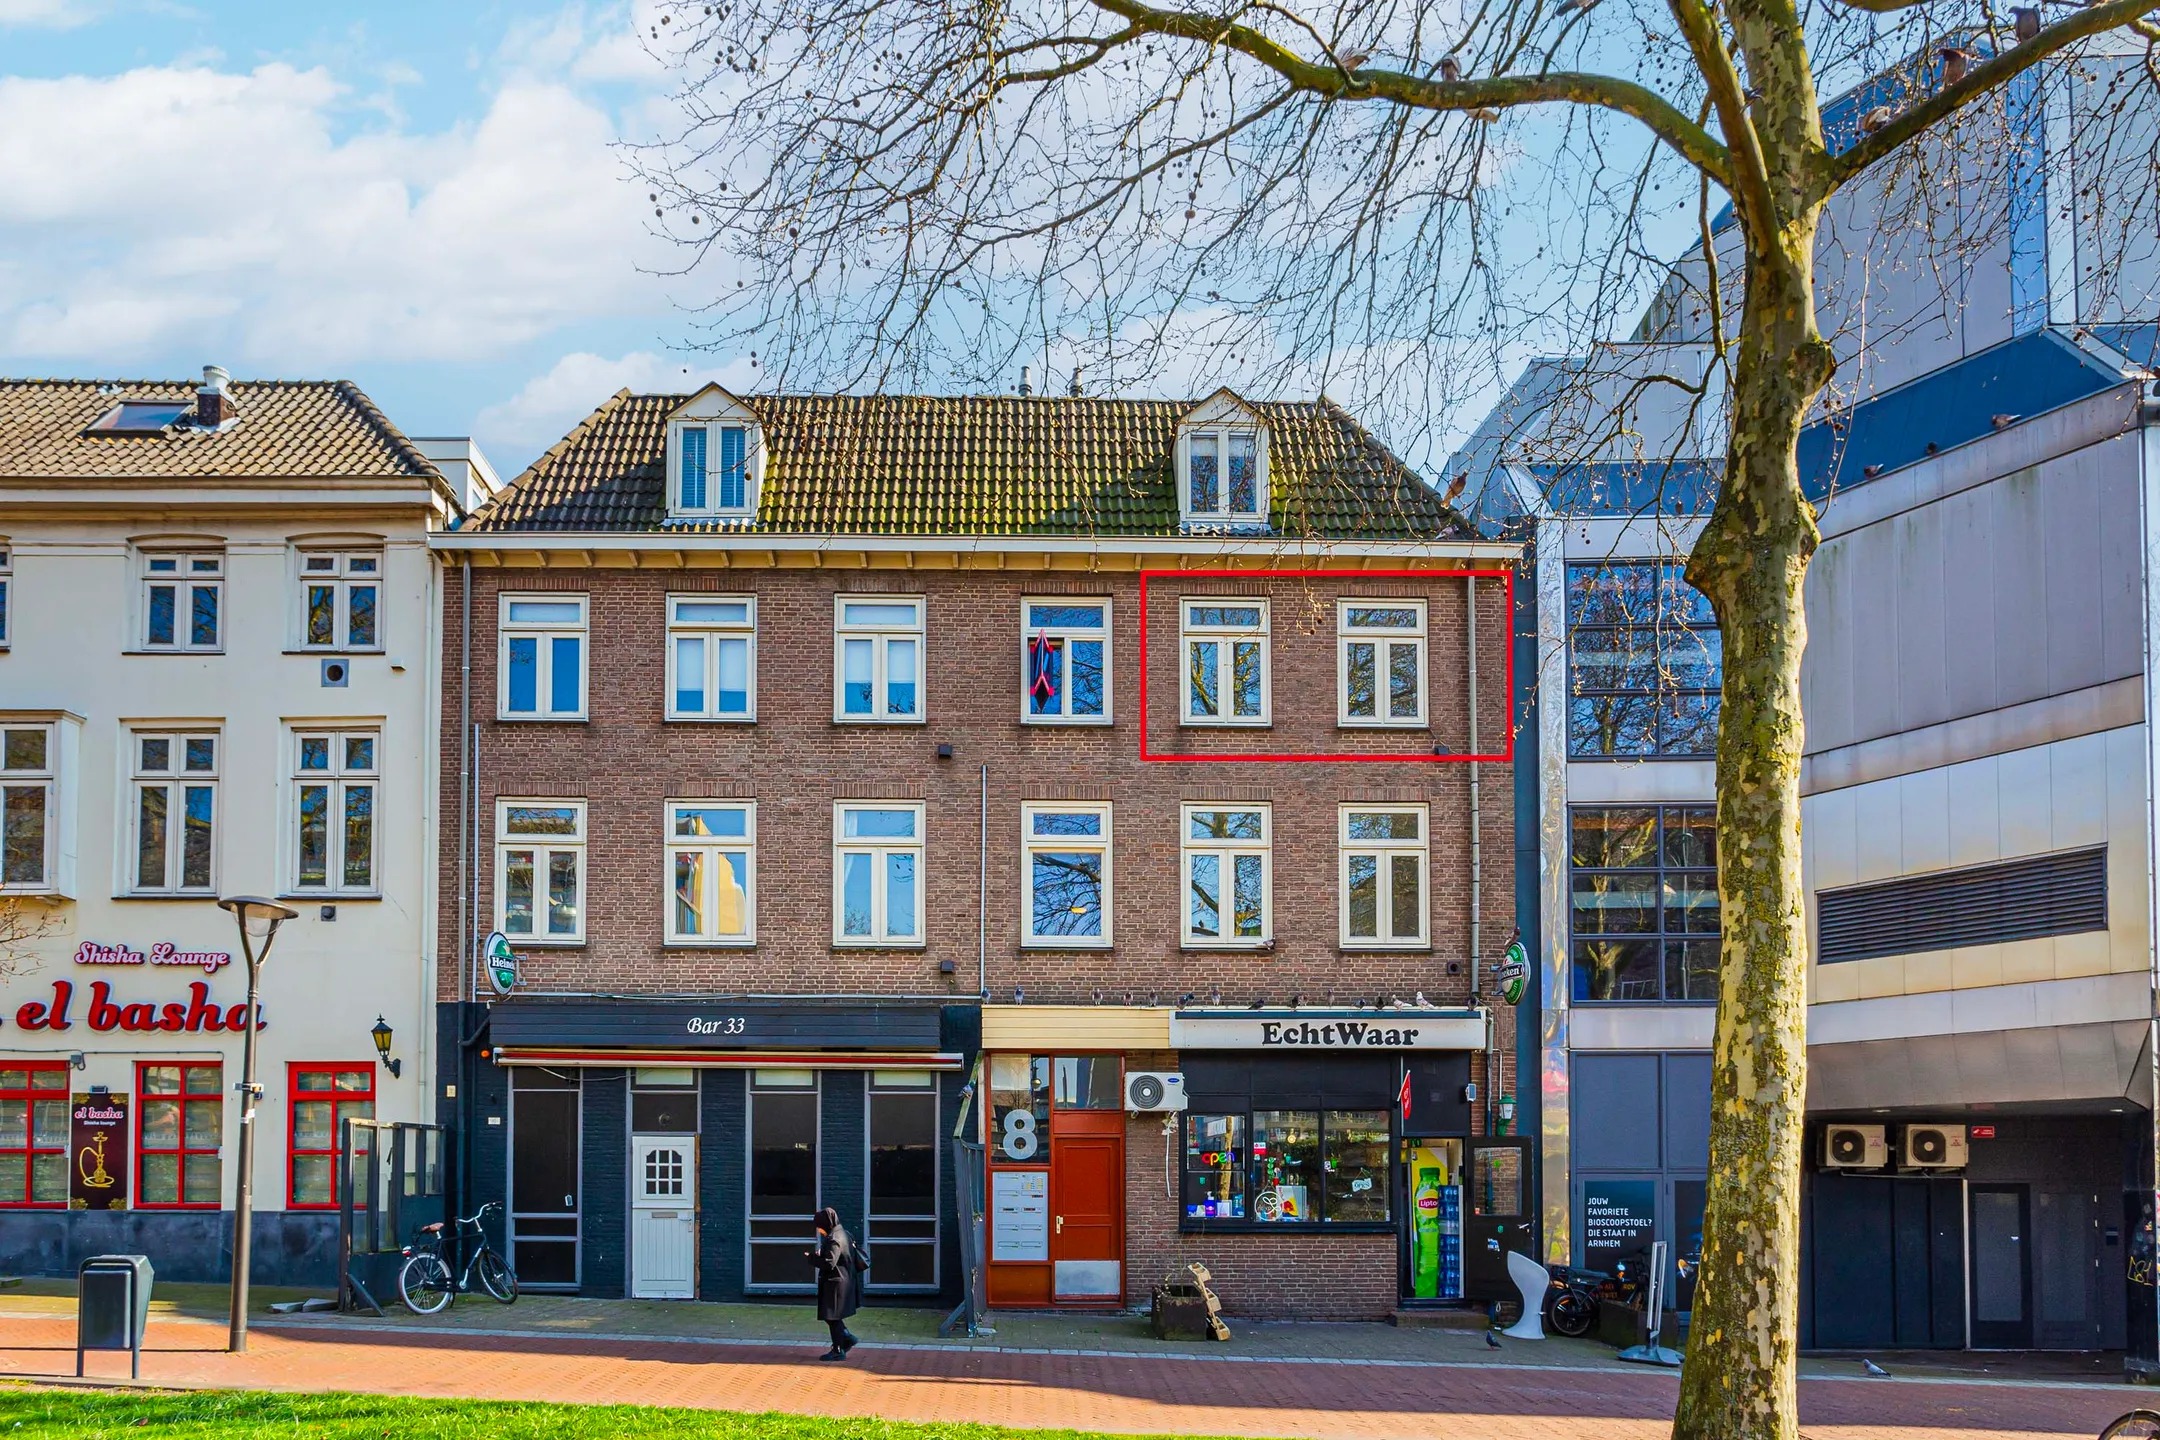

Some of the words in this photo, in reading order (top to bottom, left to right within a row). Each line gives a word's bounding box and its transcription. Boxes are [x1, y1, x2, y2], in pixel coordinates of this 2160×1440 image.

[75, 941, 144, 965] Shisha
[151, 942, 230, 973] Lounge
[16, 980, 72, 1030] el
[88, 981, 267, 1031] basha
[687, 1017, 722, 1034] Bar
[723, 1017, 745, 1034] 33
[1261, 1022, 1419, 1046] EchtWaar
[74, 1106, 87, 1119] el
[88, 1106, 124, 1119] basha
[1003, 1109, 1037, 1160] 8
[1588, 1208, 1629, 1216] FAVORIETE
[1588, 1219, 1652, 1227] BIOSCOOPSTOEL?
[1588, 1229, 1600, 1237] DIE
[1602, 1229, 1625, 1237] STAAT
[1628, 1229, 1636, 1237] IN
[1587, 1240, 1620, 1248] ARNHEM
